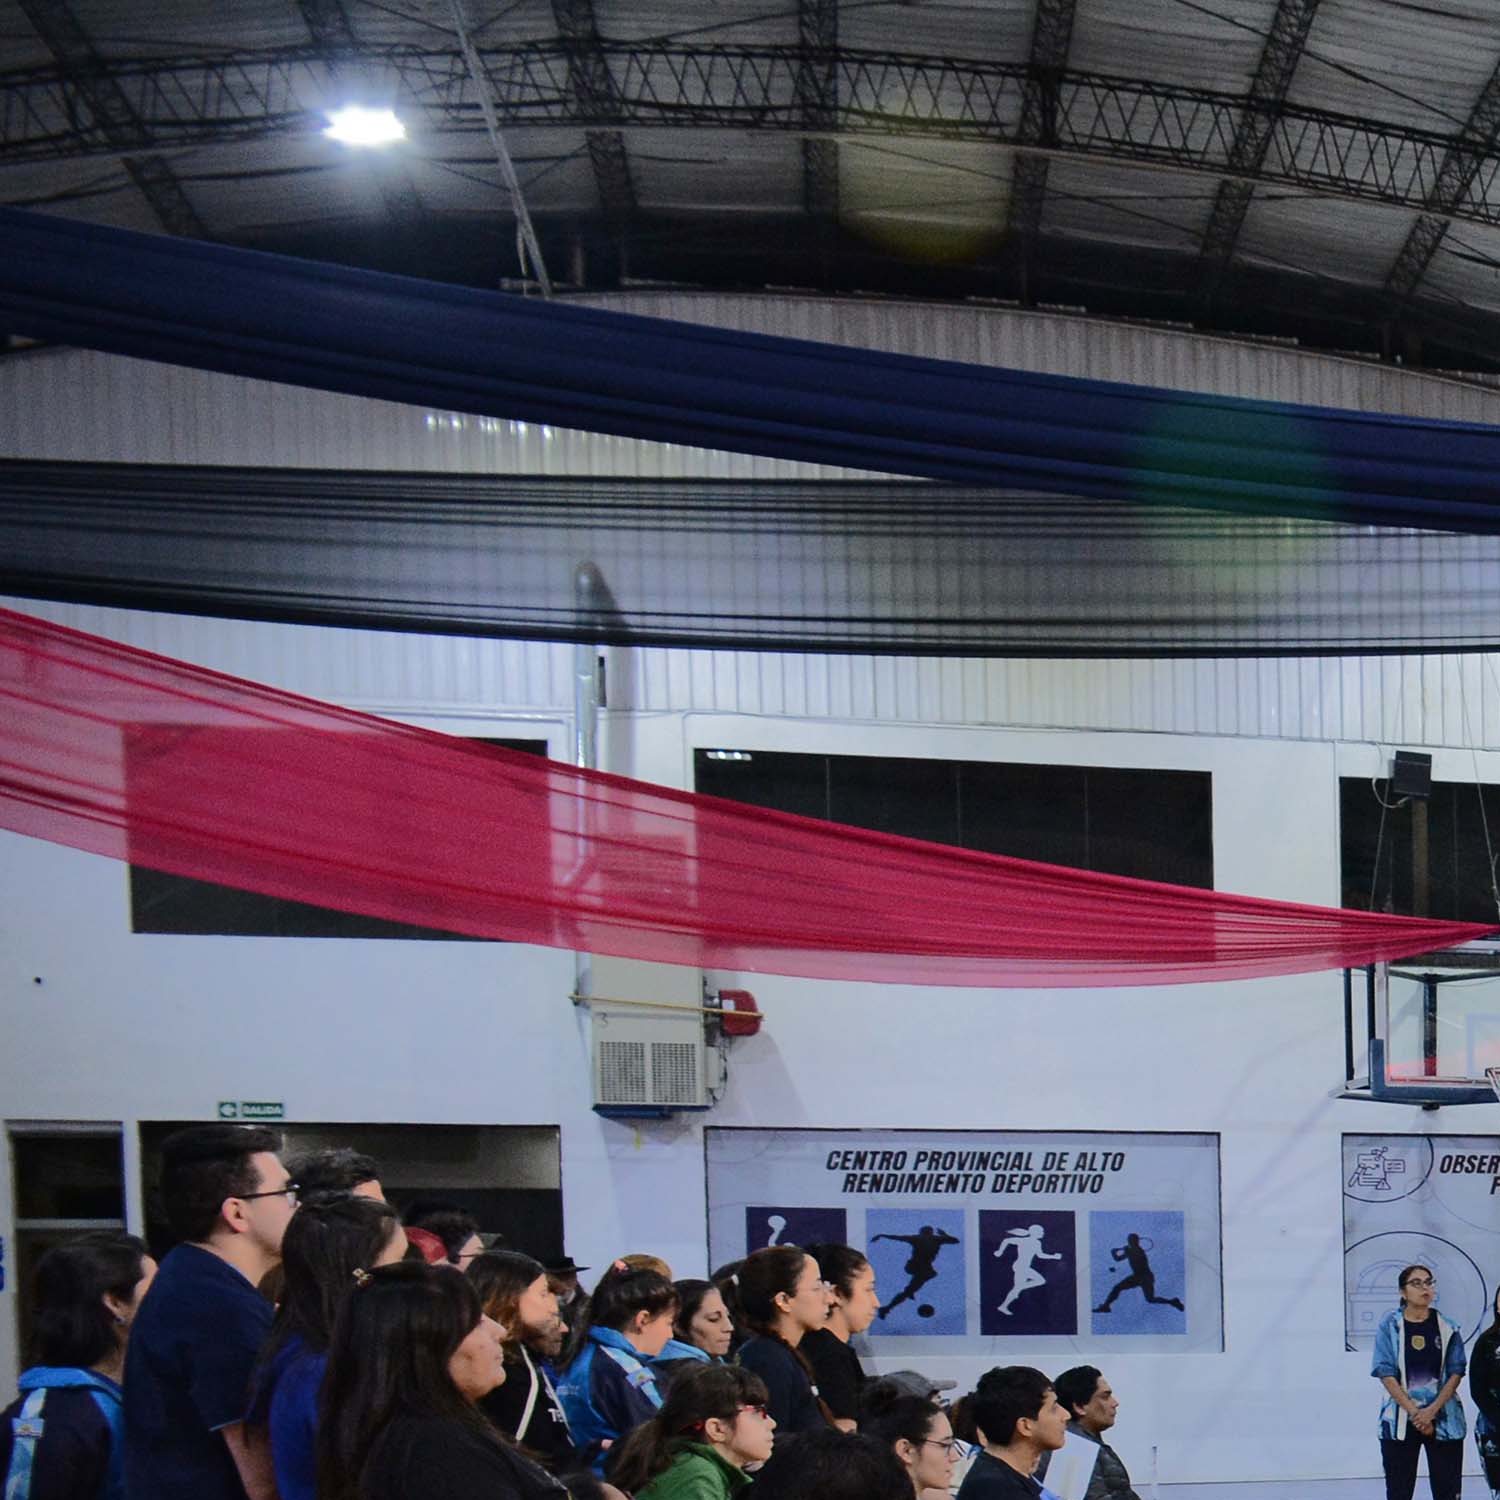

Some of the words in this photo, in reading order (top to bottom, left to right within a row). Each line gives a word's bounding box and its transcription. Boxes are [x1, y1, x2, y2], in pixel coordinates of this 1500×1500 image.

[826, 1150, 905, 1171] CENTRO
[912, 1151, 1034, 1171] PROVINCIAL
[1041, 1152, 1067, 1171] DE
[1074, 1152, 1126, 1172] ALTO
[842, 1173, 986, 1193] RENDIMIENTO
[991, 1174, 1105, 1193] DEPORTIVO
